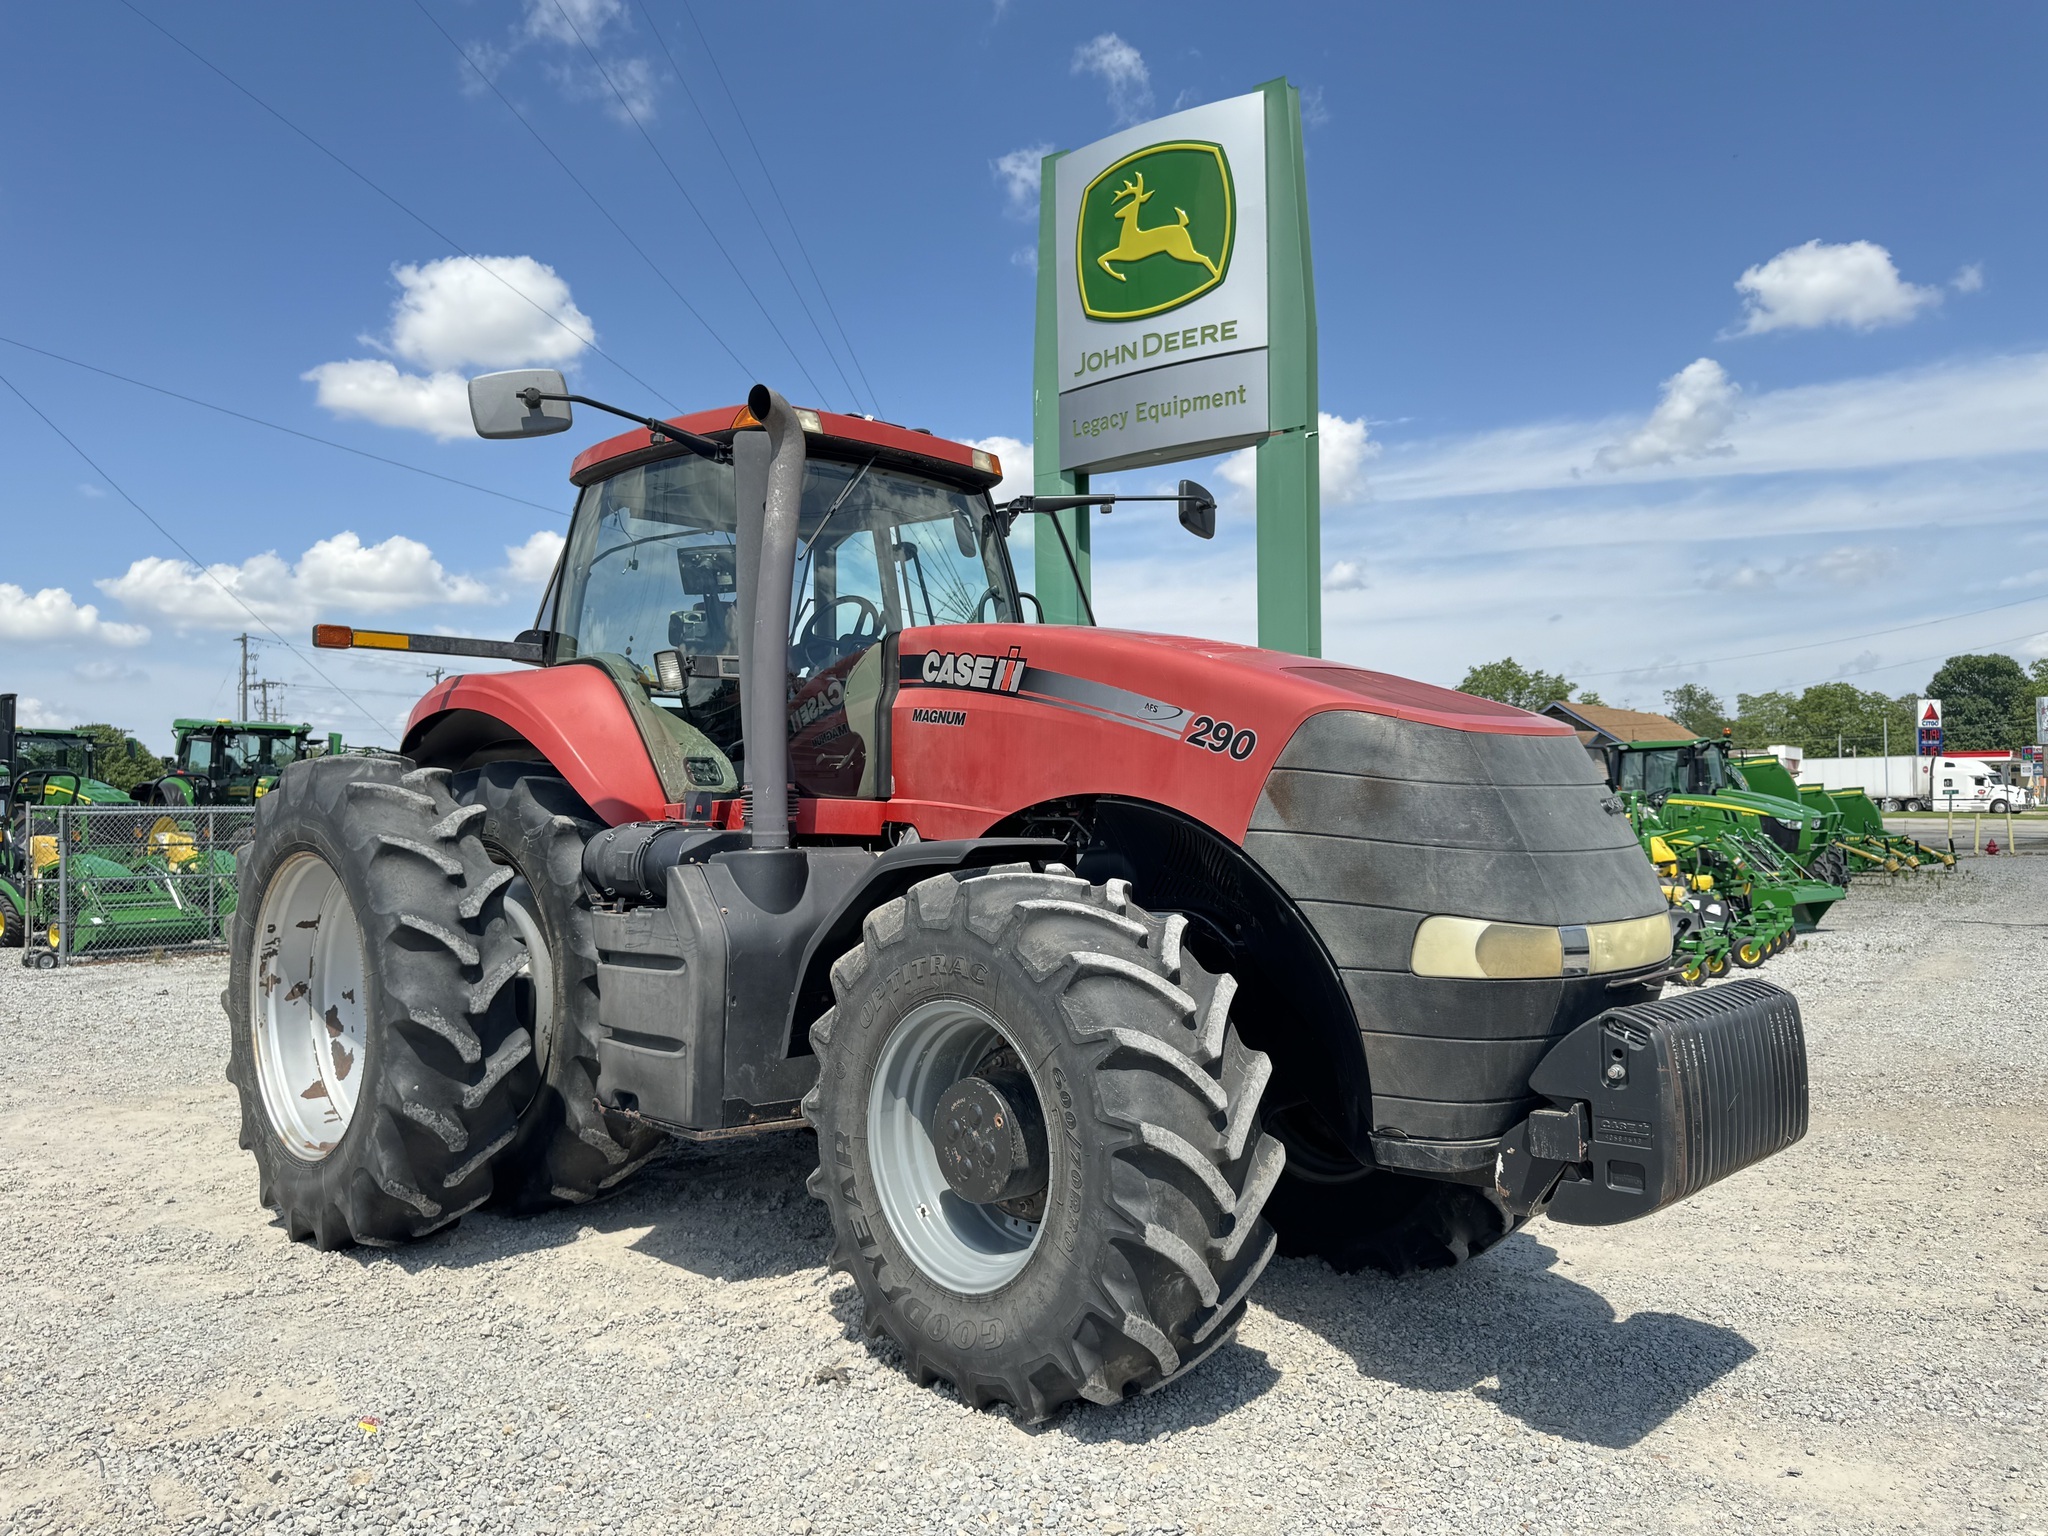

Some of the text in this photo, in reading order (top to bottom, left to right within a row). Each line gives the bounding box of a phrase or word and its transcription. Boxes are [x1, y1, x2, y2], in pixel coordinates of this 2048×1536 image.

[1074, 319, 1238, 377] JOHN DEERE
[1073, 385, 1246, 439] Legacy Equipment
[912, 708, 967, 726] MAGNUM
[1144, 702, 1159, 713] AFS
[1186, 716, 1257, 761] 290
[859, 953, 990, 1029] OPTITRAC
[834, 1130, 1006, 1351] GOODYEAR
